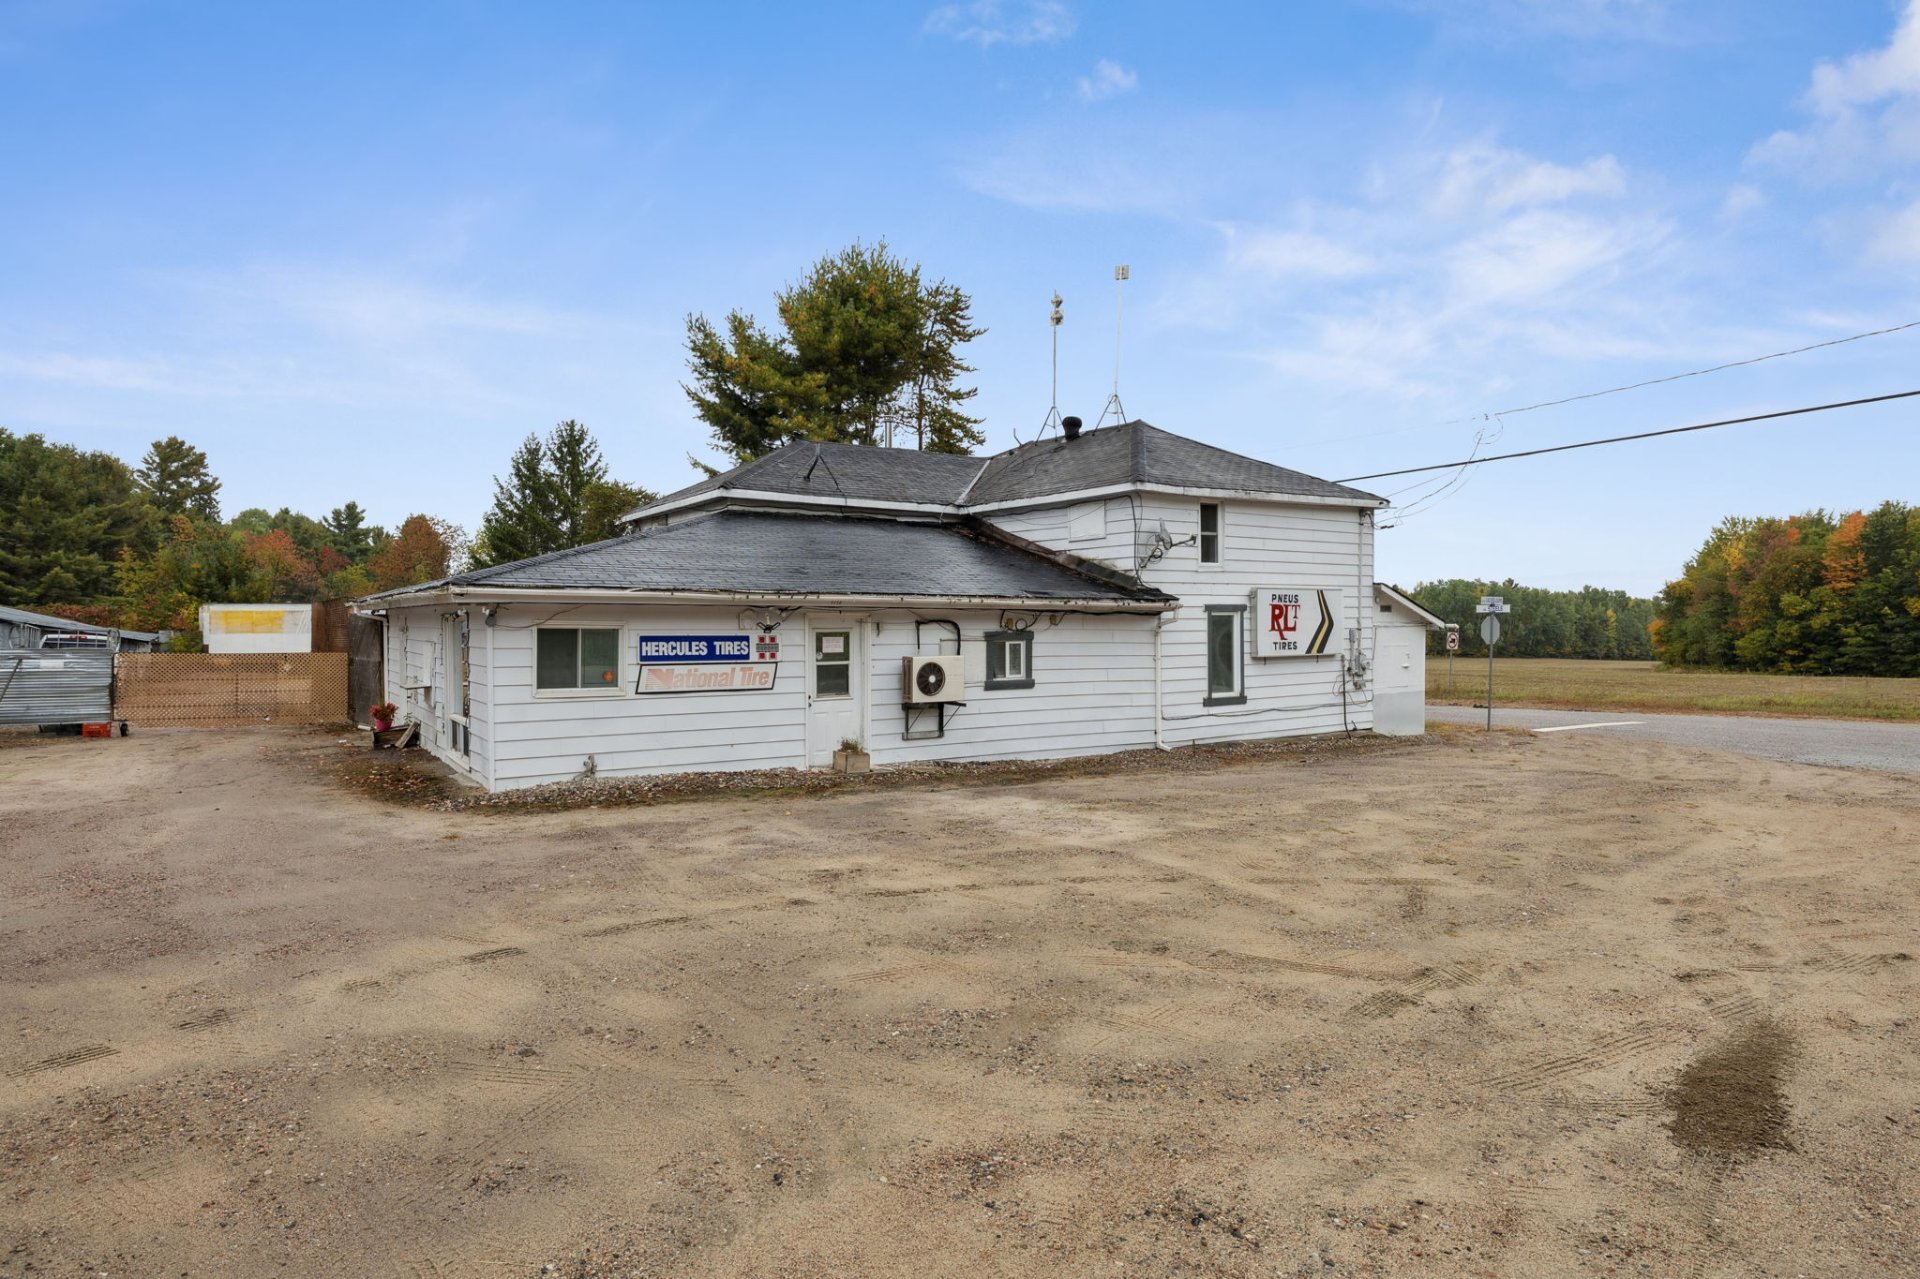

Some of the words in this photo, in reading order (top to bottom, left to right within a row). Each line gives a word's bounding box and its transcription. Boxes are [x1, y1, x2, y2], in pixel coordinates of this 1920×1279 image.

[1271, 594, 1299, 603] PNEUS
[641, 641, 708, 656] HERCULES
[713, 641, 749, 655] TIRES
[1272, 641, 1298, 650] TIRES
[645, 667, 737, 690] National
[740, 666, 770, 686] Tire
